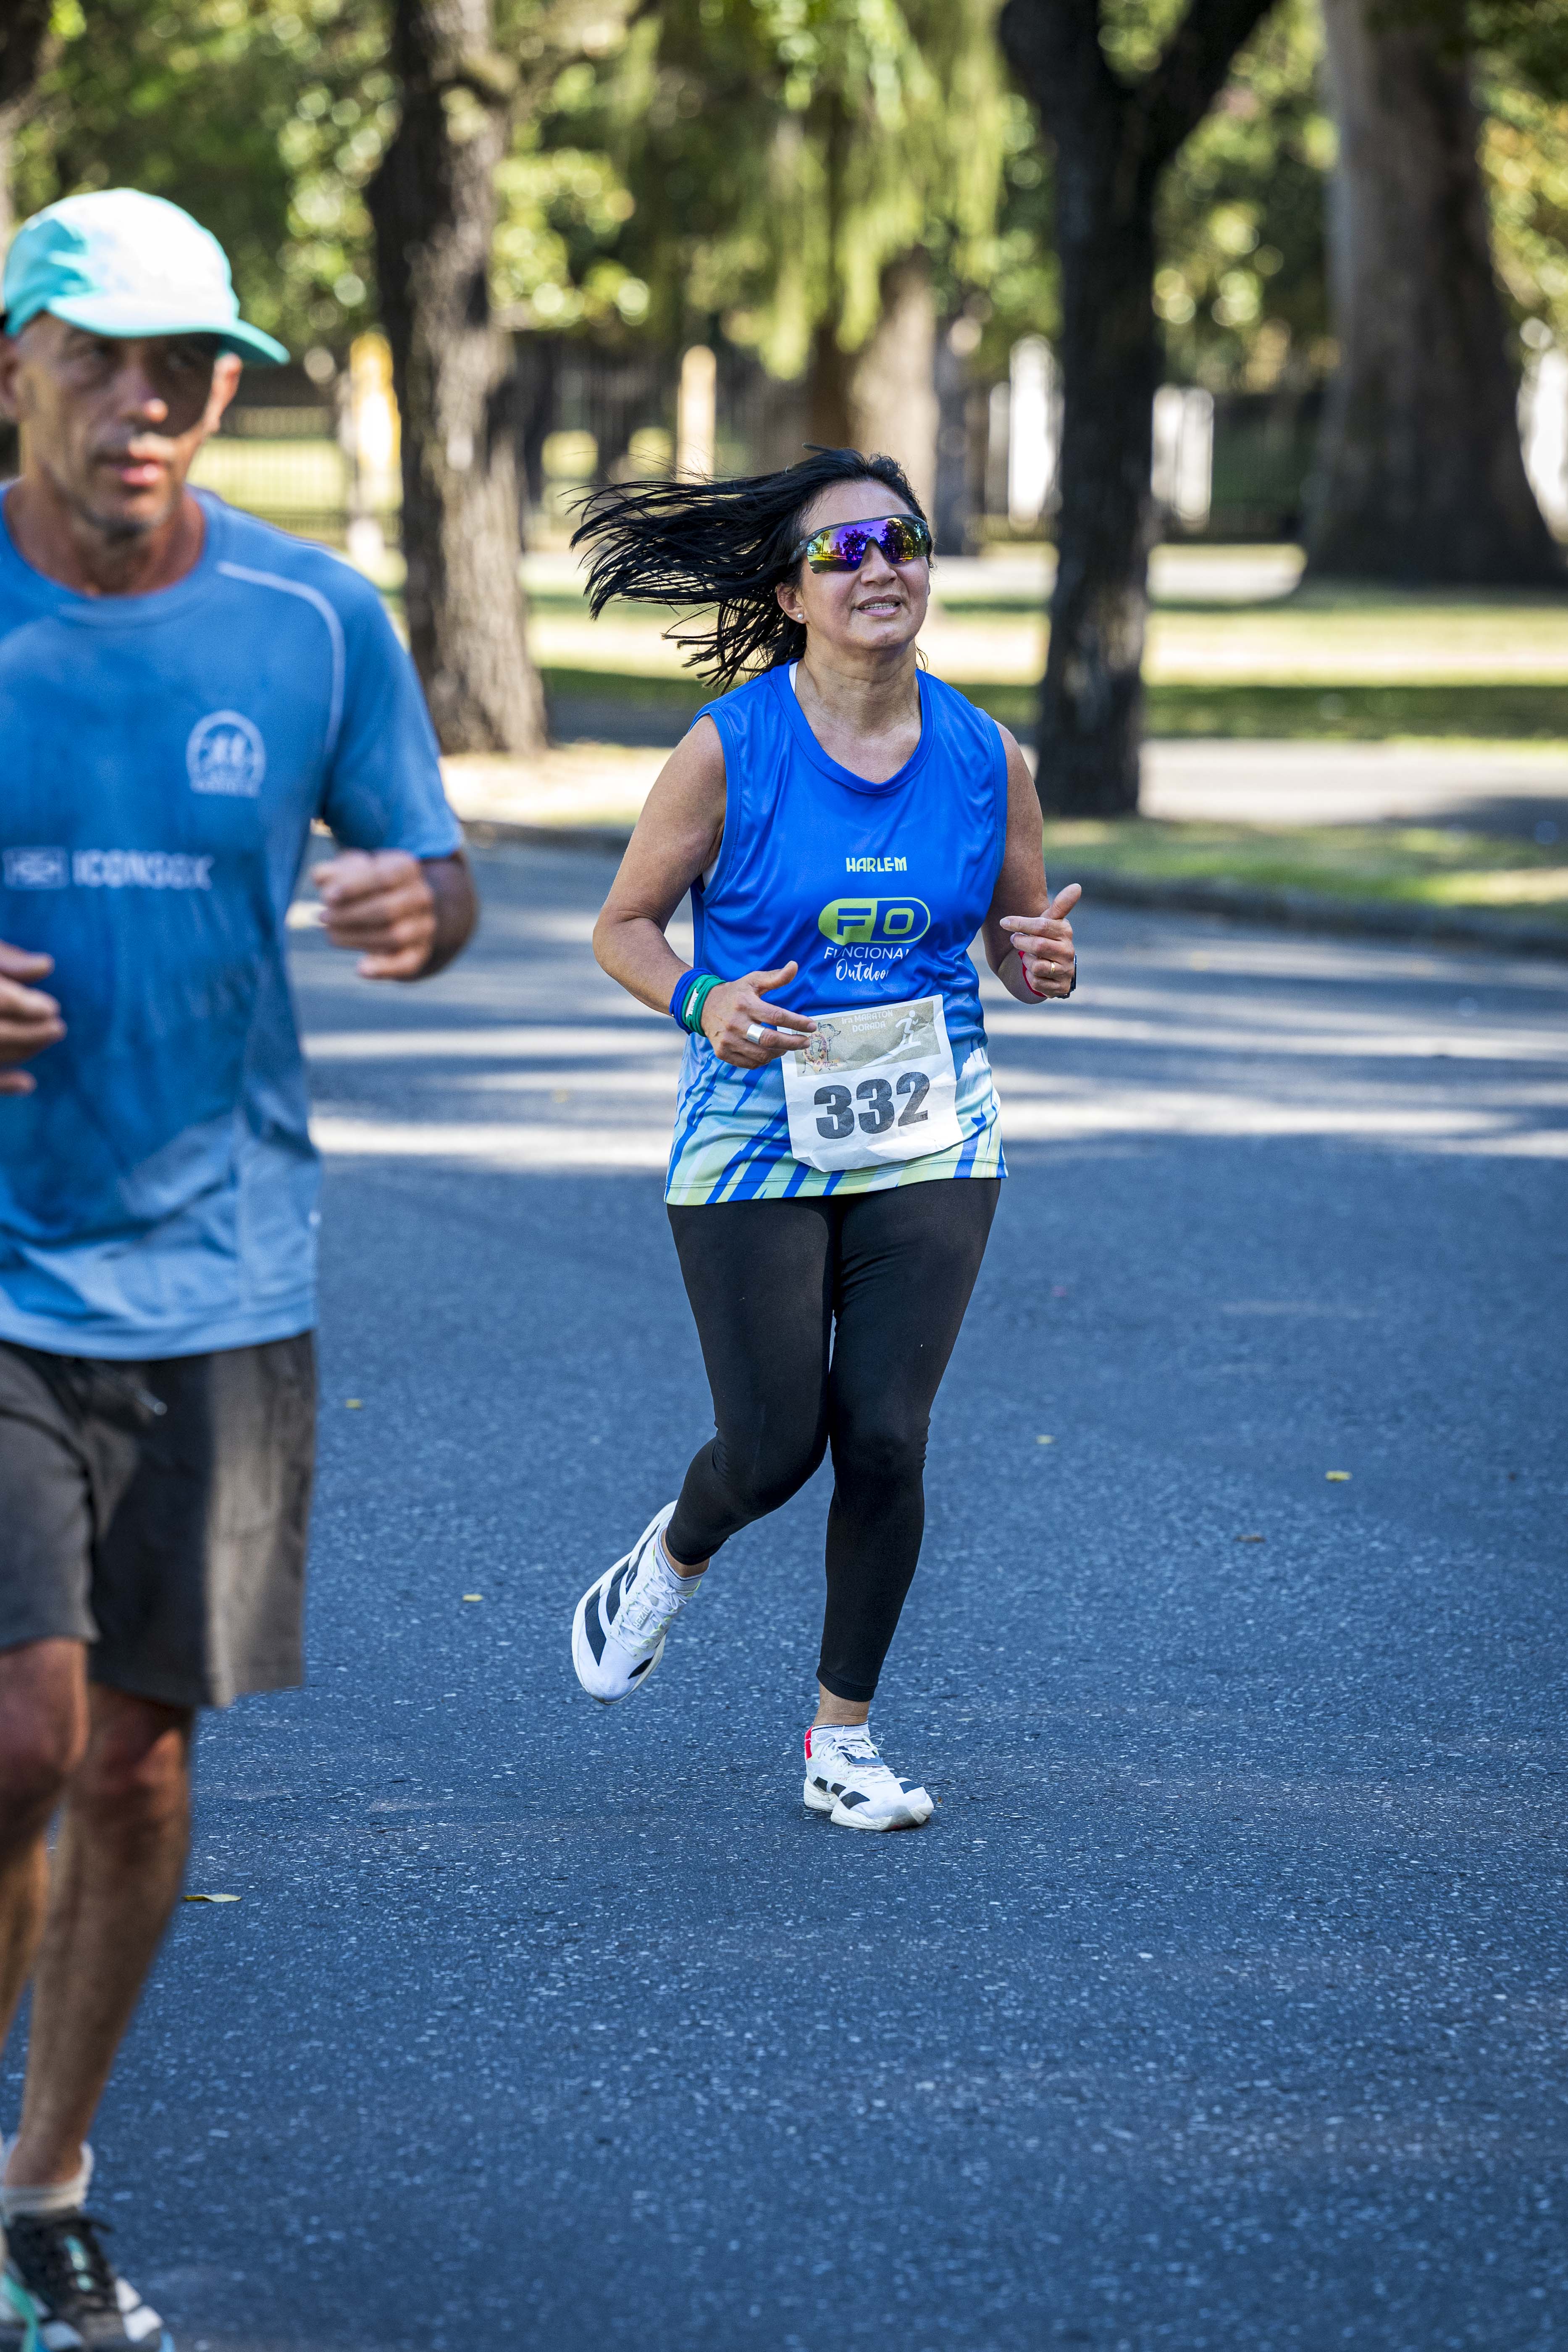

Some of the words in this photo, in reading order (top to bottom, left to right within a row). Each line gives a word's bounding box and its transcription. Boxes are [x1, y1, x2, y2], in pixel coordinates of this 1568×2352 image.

[846, 857, 907, 872] HARLEM
[854, 1009, 893, 1022] MARATON
[852, 1021, 886, 1033] DORADA
[814, 1072, 930, 1139] 332
[633, 1606, 651, 1629] DIZER
